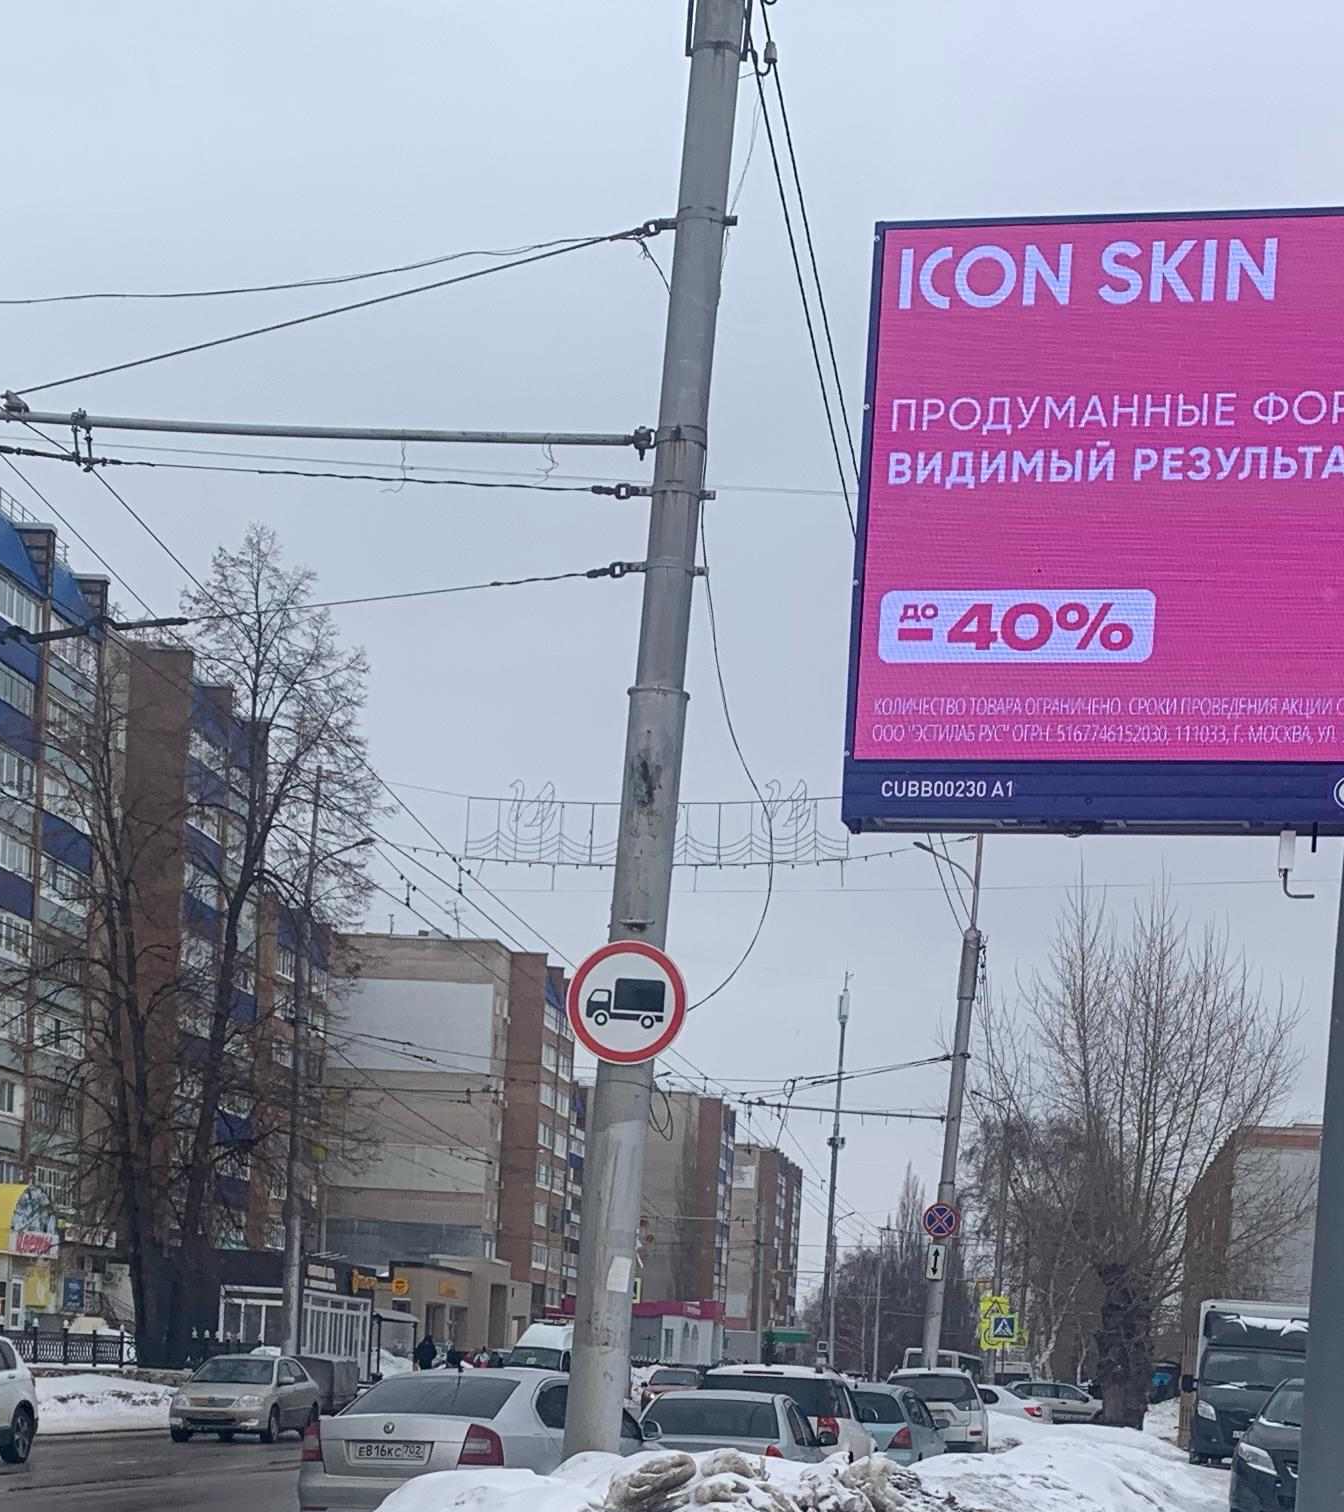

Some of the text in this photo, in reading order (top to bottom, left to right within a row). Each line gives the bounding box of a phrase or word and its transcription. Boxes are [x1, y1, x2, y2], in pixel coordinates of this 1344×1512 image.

[898, 238, 1278, 309] ICON SKIN
[891, 393, 1236, 435] ПРОДУМАННЫЕ
[887, 441, 1115, 489] ВИДИМЫЙ
[873, 697, 966, 717] КОЛИЧЕСТВО
[970, 697, 1022, 716] ТОВАРА
[1128, 697, 1177, 716] СРОКИ
[1181, 697, 1278, 719] ПРОВЕДЕНИЯ
[1281, 697, 1333, 719] АКЦИИ
[872, 724, 905, 743] ООО
[881, 781, 1014, 797] CUBB00230 A1
